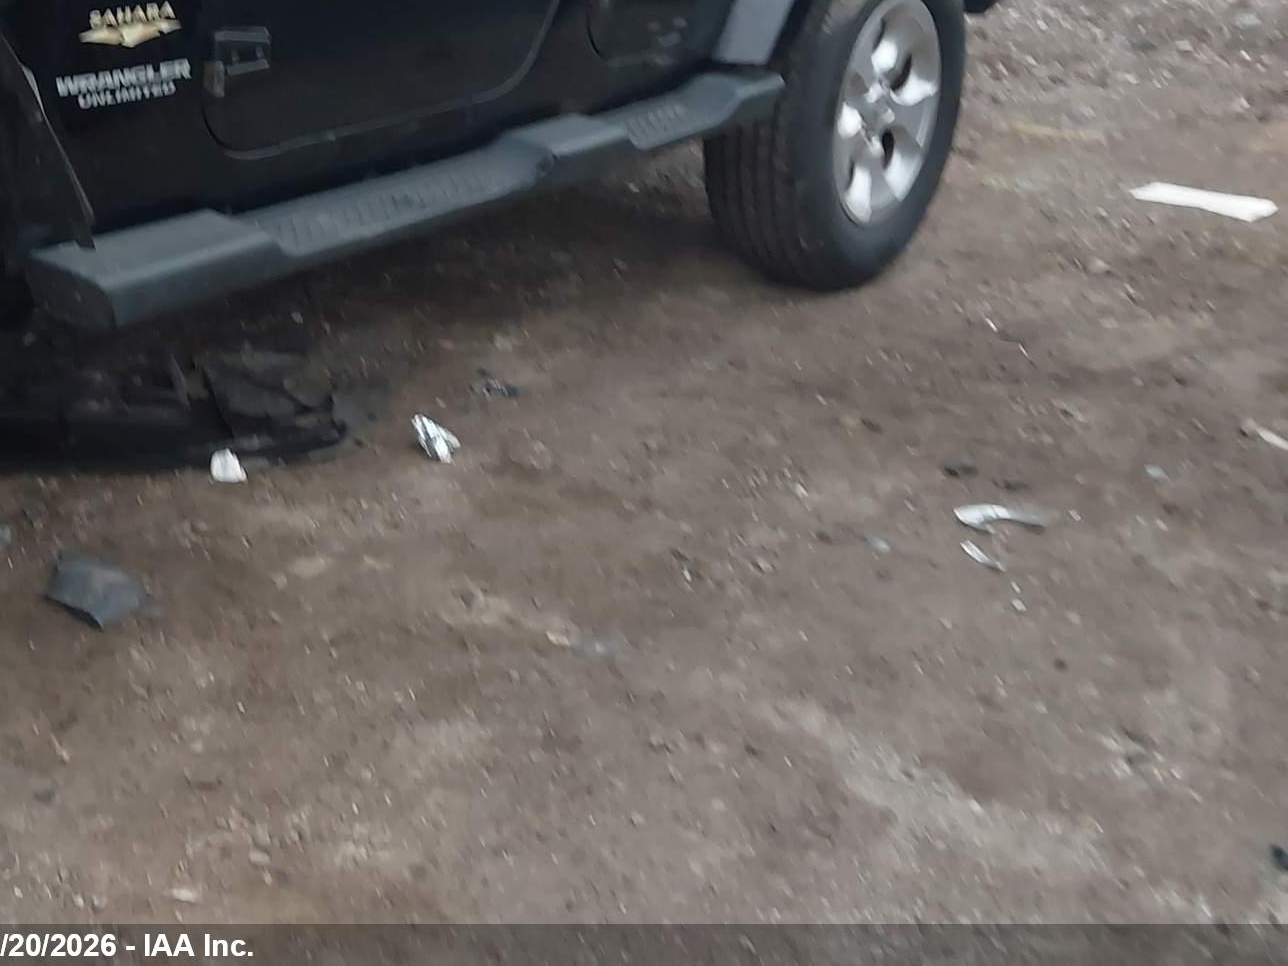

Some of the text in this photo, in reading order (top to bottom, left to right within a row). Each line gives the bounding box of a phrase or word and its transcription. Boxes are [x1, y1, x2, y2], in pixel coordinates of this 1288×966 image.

[89, 0, 176, 30] SAHARA
[55, 58, 192, 97] WRANGLER
[77, 81, 176, 110] UNLIMITED
